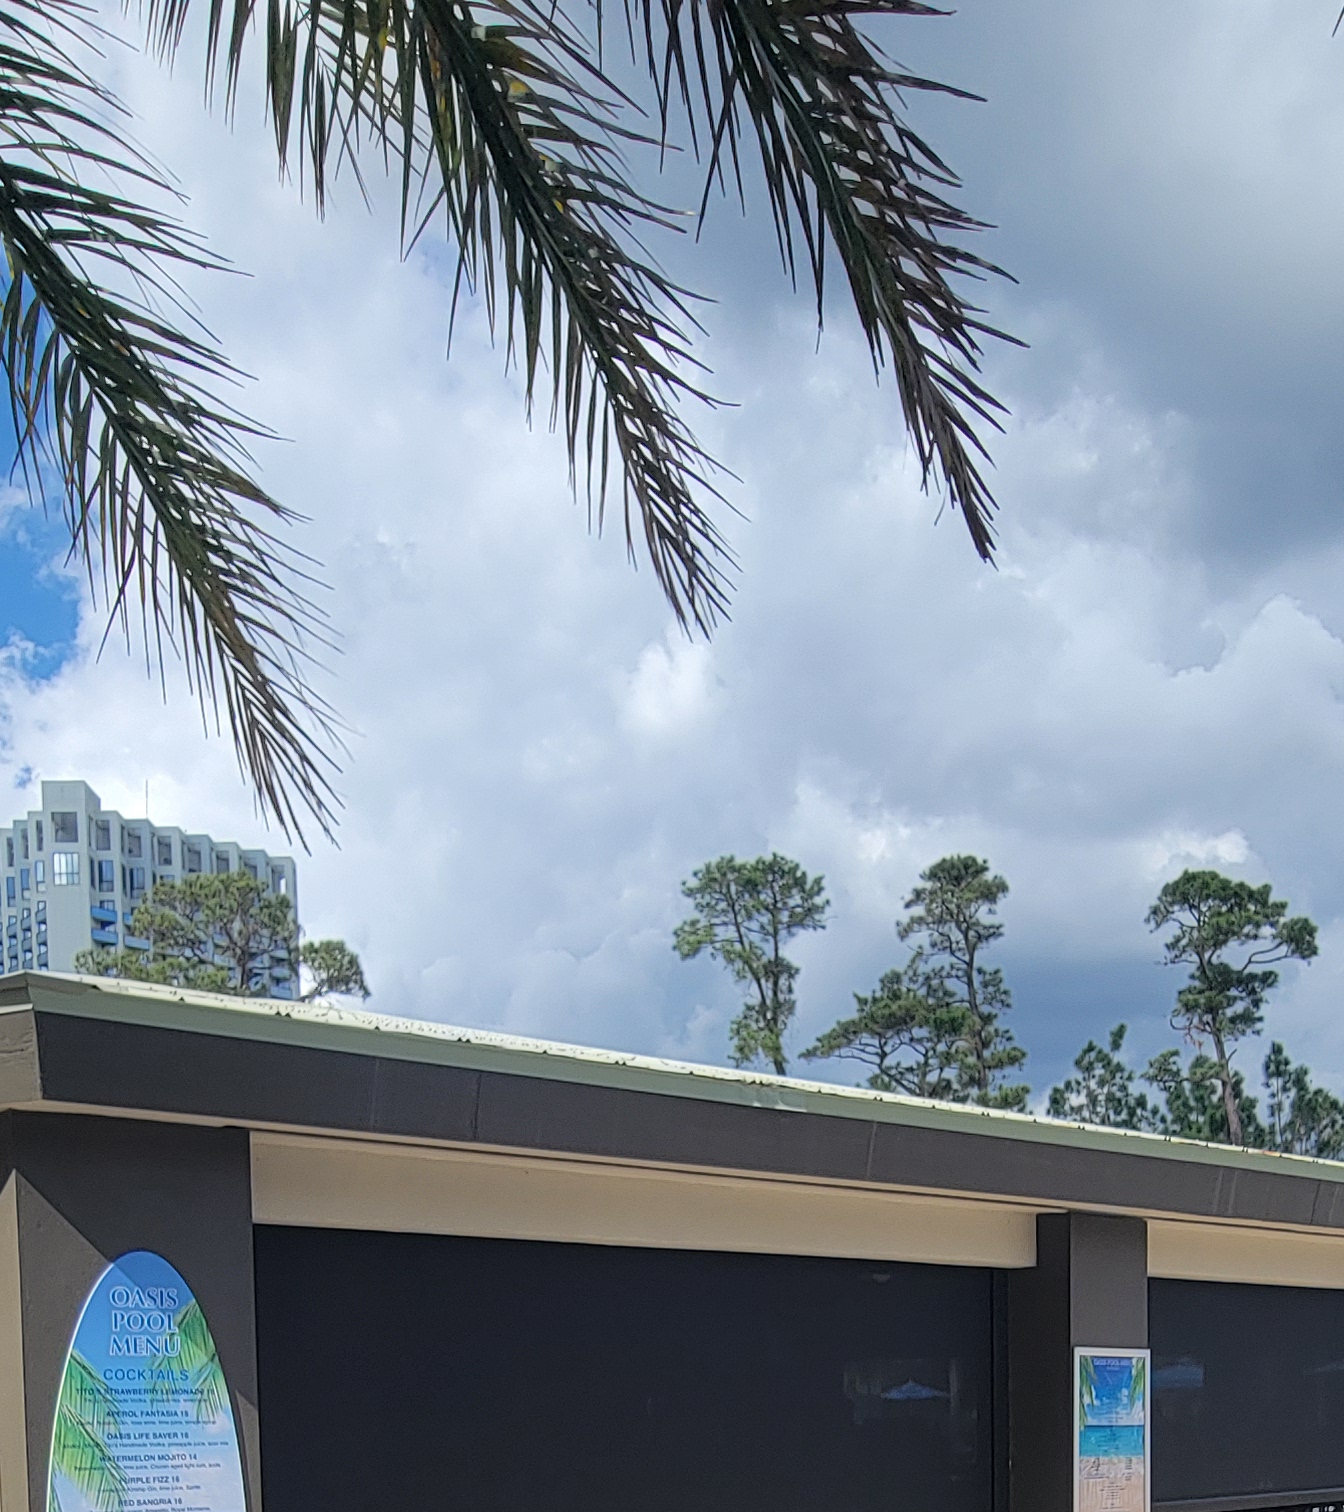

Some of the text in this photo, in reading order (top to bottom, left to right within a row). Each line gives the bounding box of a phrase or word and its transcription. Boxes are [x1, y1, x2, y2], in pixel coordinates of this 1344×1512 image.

[109, 1285, 179, 1309] OASIS
[111, 1310, 179, 1333] POOL
[109, 1334, 181, 1357] MENU
[103, 1368, 189, 1381] COCKTAILS
[140, 1410, 179, 1418] FANTASIA
[152, 1432, 178, 1440] SAVER
[99, 1453, 197, 1463] WATERMELON MOJITO 14
[153, 1476, 169, 1484] FIZZ
[118, 1499, 135, 1507] RED
[136, 1498, 172, 1506] SANGRIA
